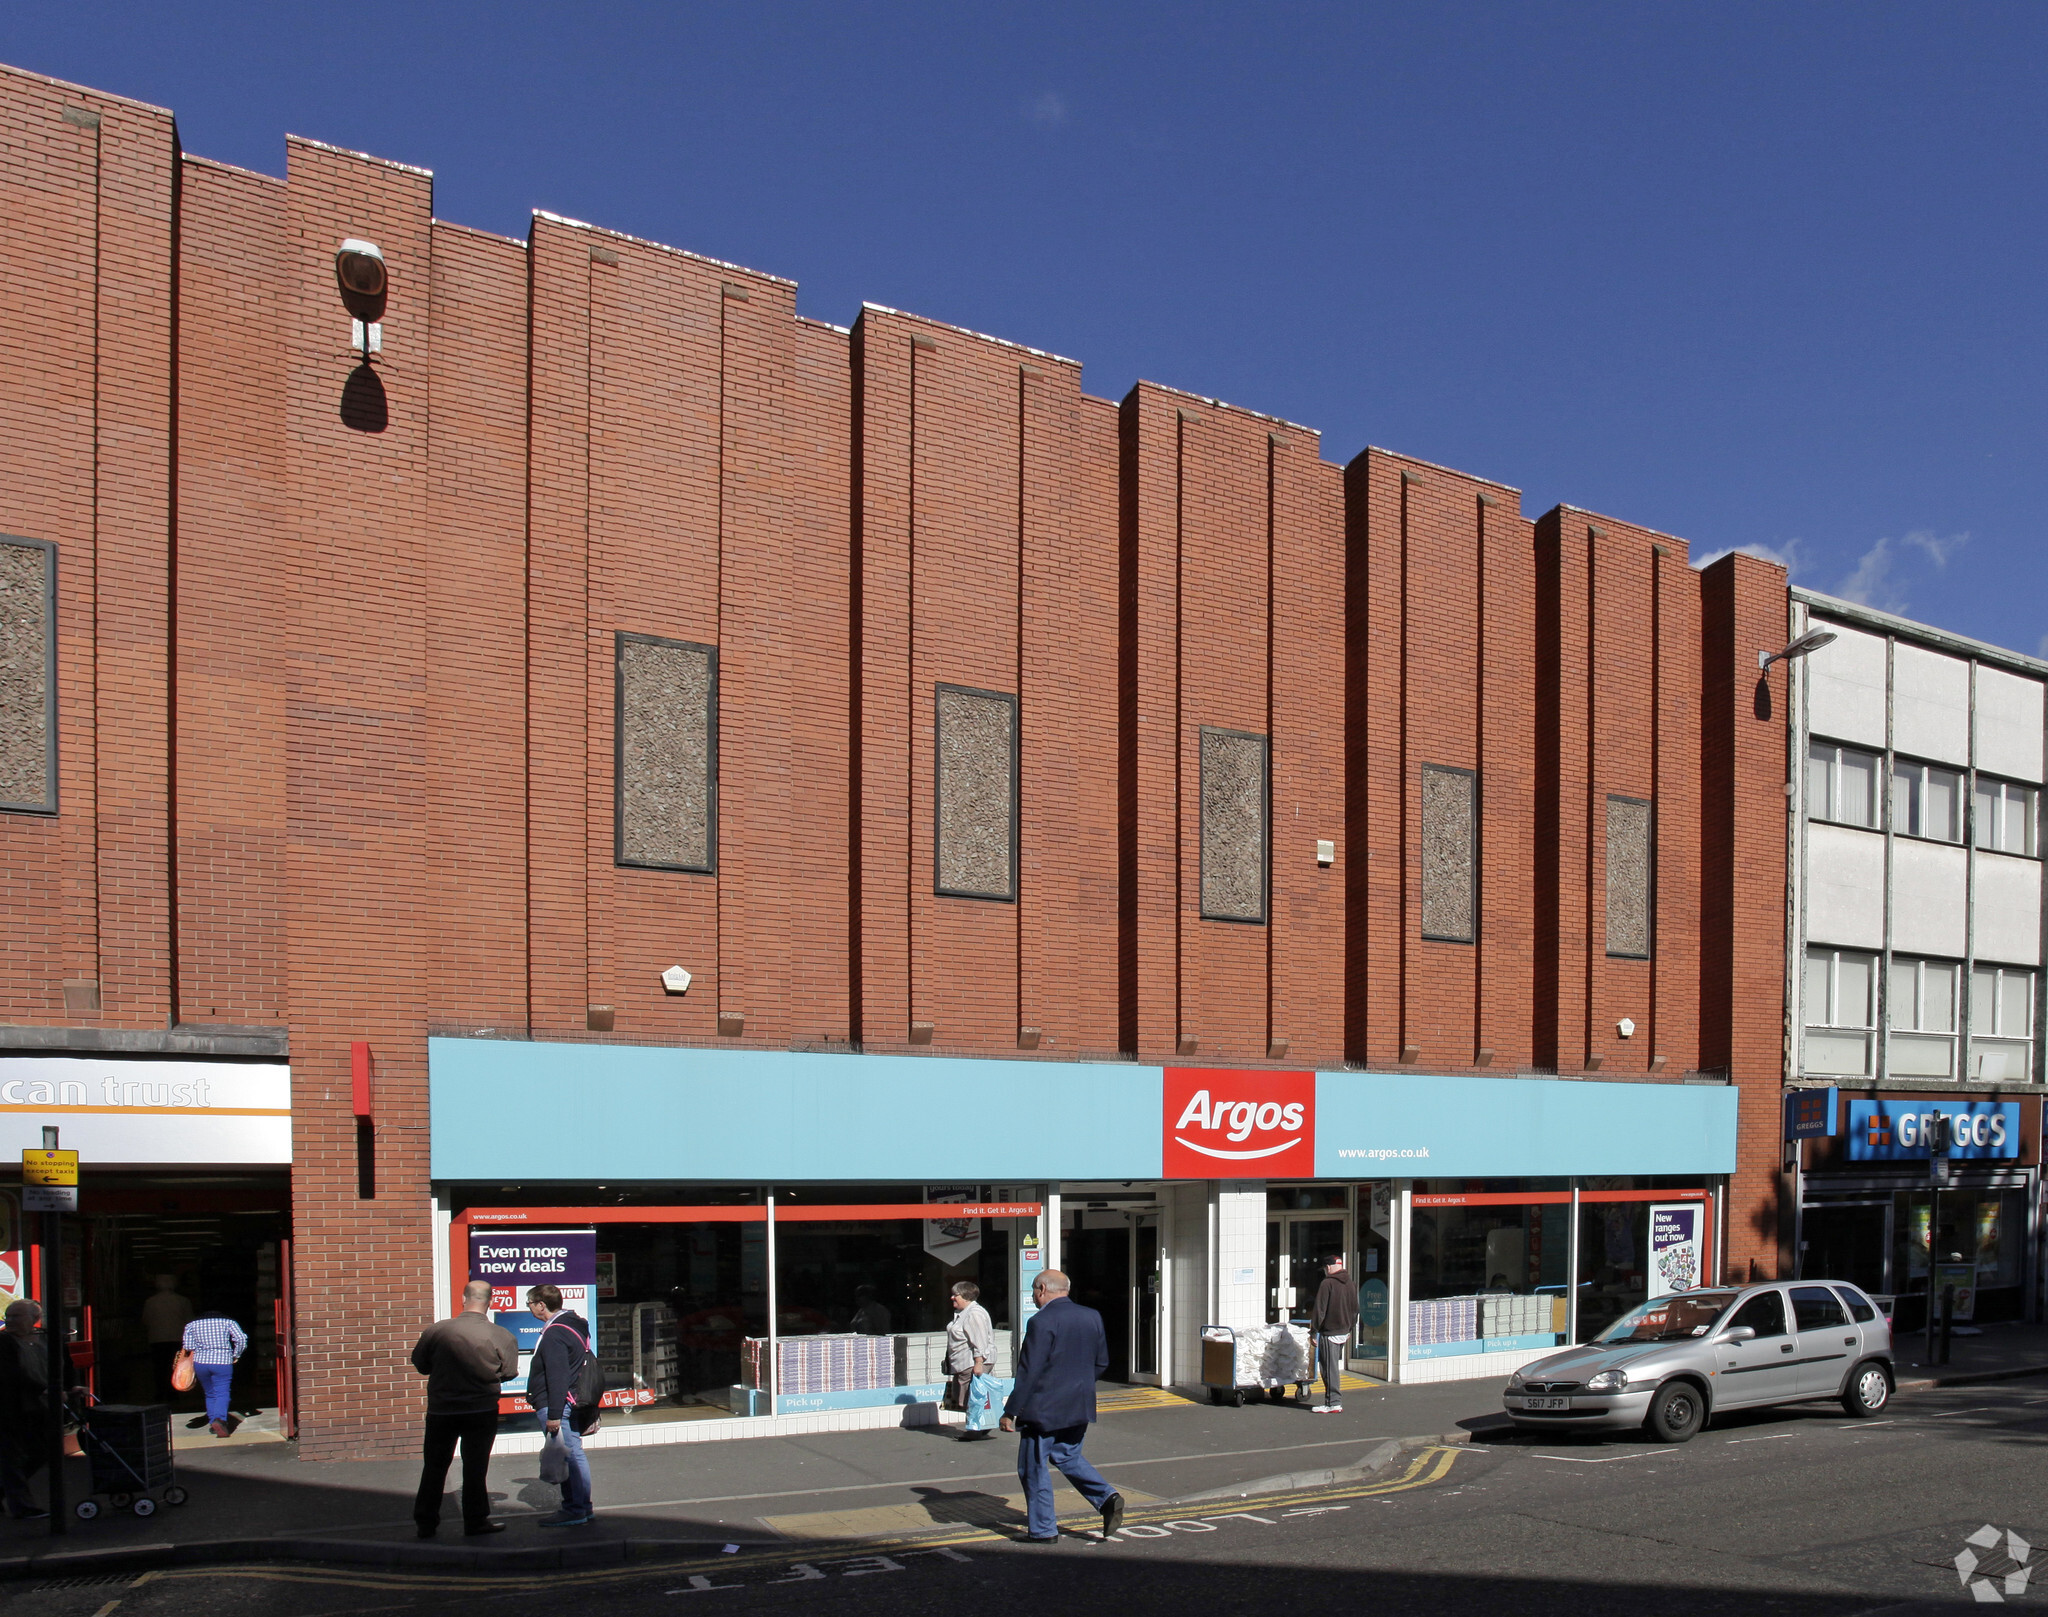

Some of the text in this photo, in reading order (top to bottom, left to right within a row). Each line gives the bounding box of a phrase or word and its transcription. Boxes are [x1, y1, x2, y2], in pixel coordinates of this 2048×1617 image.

[1, 1075, 211, 1108] can trust
[1175, 1089, 1305, 1142] Argos
[1796, 1120, 1824, 1130] GREGGS
[1898, 1112, 2006, 1147] GRGGS
[1338, 1147, 1430, 1161] www.argos.co.uk
[1008, 1206, 1027, 1216] Argos
[473, 1213, 528, 1221] www.argos.co.uk
[1655, 1214, 1673, 1223] New
[1655, 1224, 1681, 1234] ranges
[1654, 1234, 1669, 1242] out
[479, 1245, 568, 1258] Even more
[480, 1259, 565, 1273] new deals
[492, 1288, 510, 1296] Save
[494, 1296, 514, 1307] £70
[1423, 1348, 1432, 1356] up
[915, 1388, 937, 1397] Pick
[786, 1398, 823, 1407] Pick up
[1527, 1398, 1564, 1408] S617 JFP
